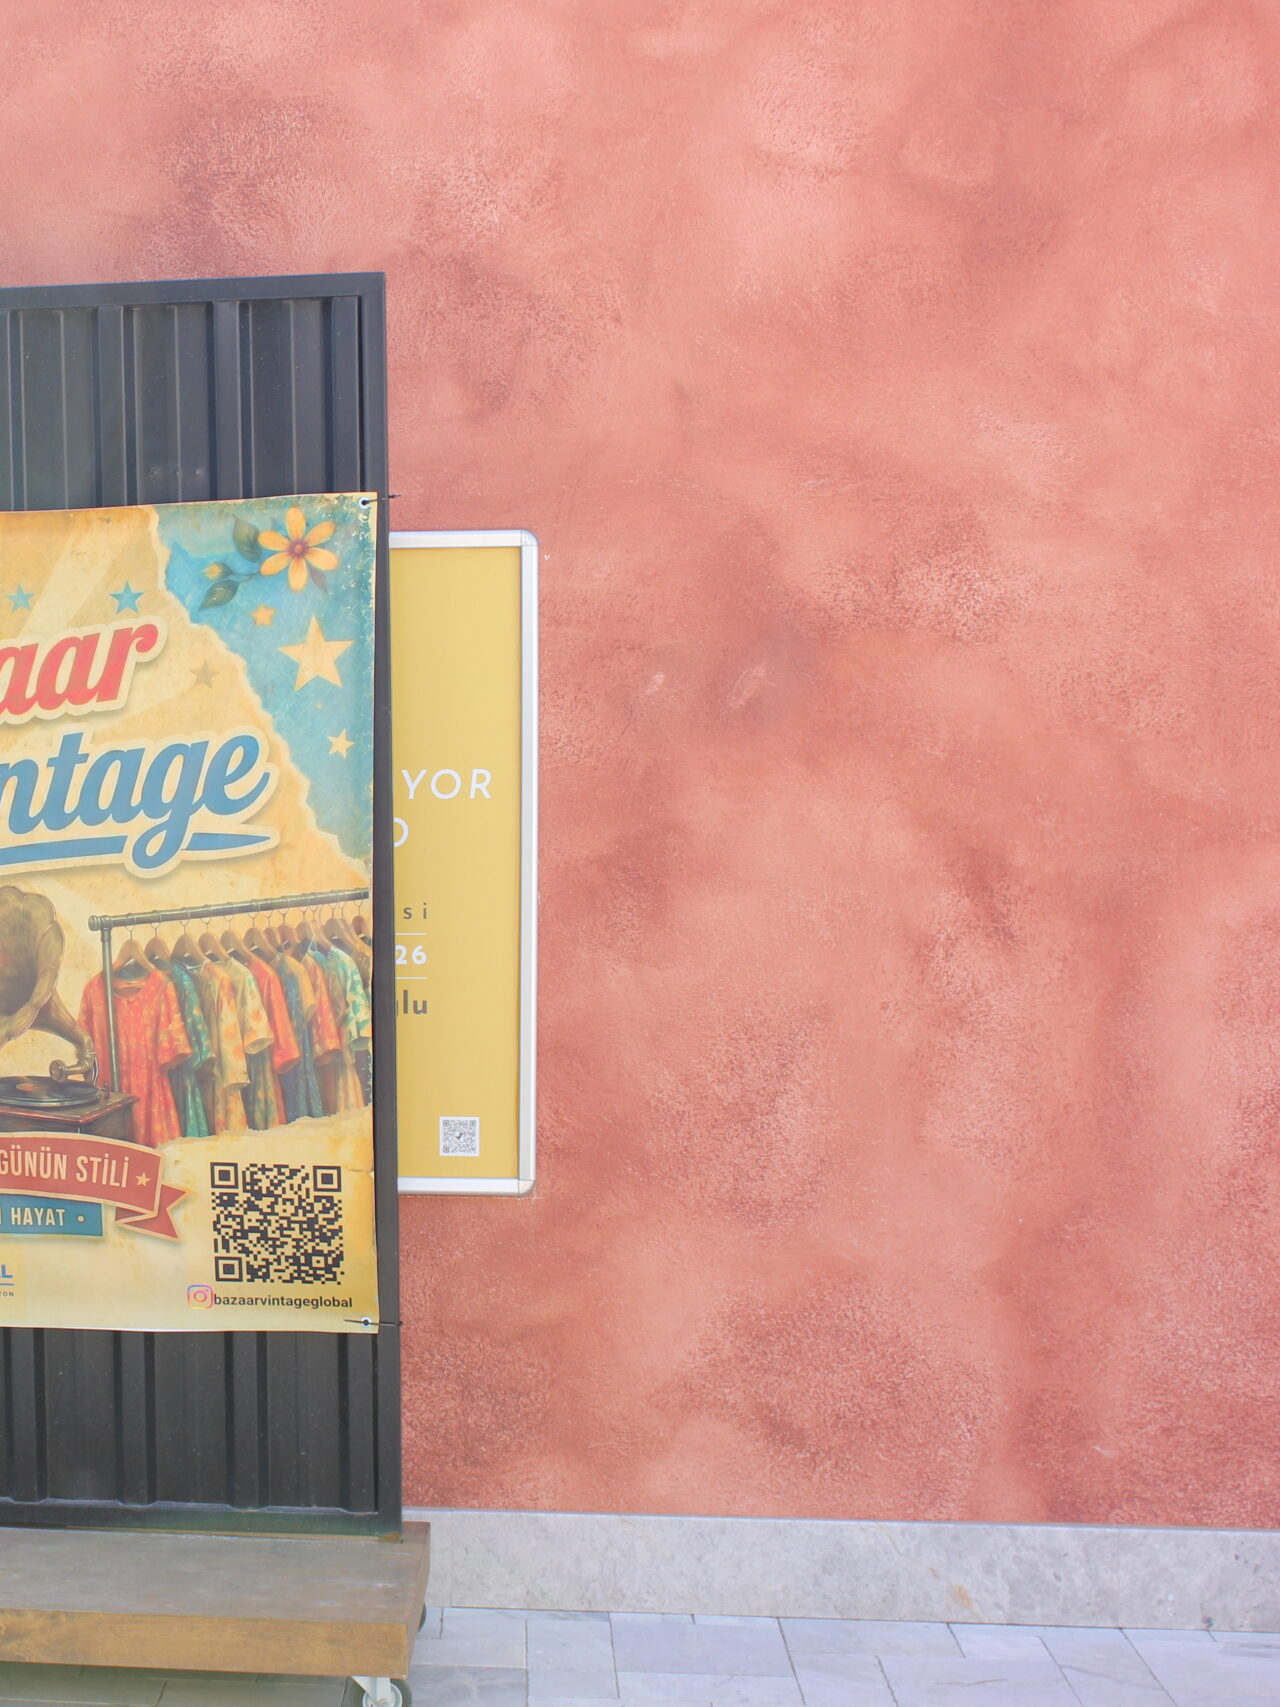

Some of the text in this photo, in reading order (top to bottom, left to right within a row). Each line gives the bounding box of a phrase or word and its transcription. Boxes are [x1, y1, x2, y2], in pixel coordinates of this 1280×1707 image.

[395, 989, 428, 1016] lu
[75, 1153, 129, 1188] STİLİ
[11, 1207, 66, 1227] HAYAT
[213, 1294, 353, 1309] bazaarvintageglobal
